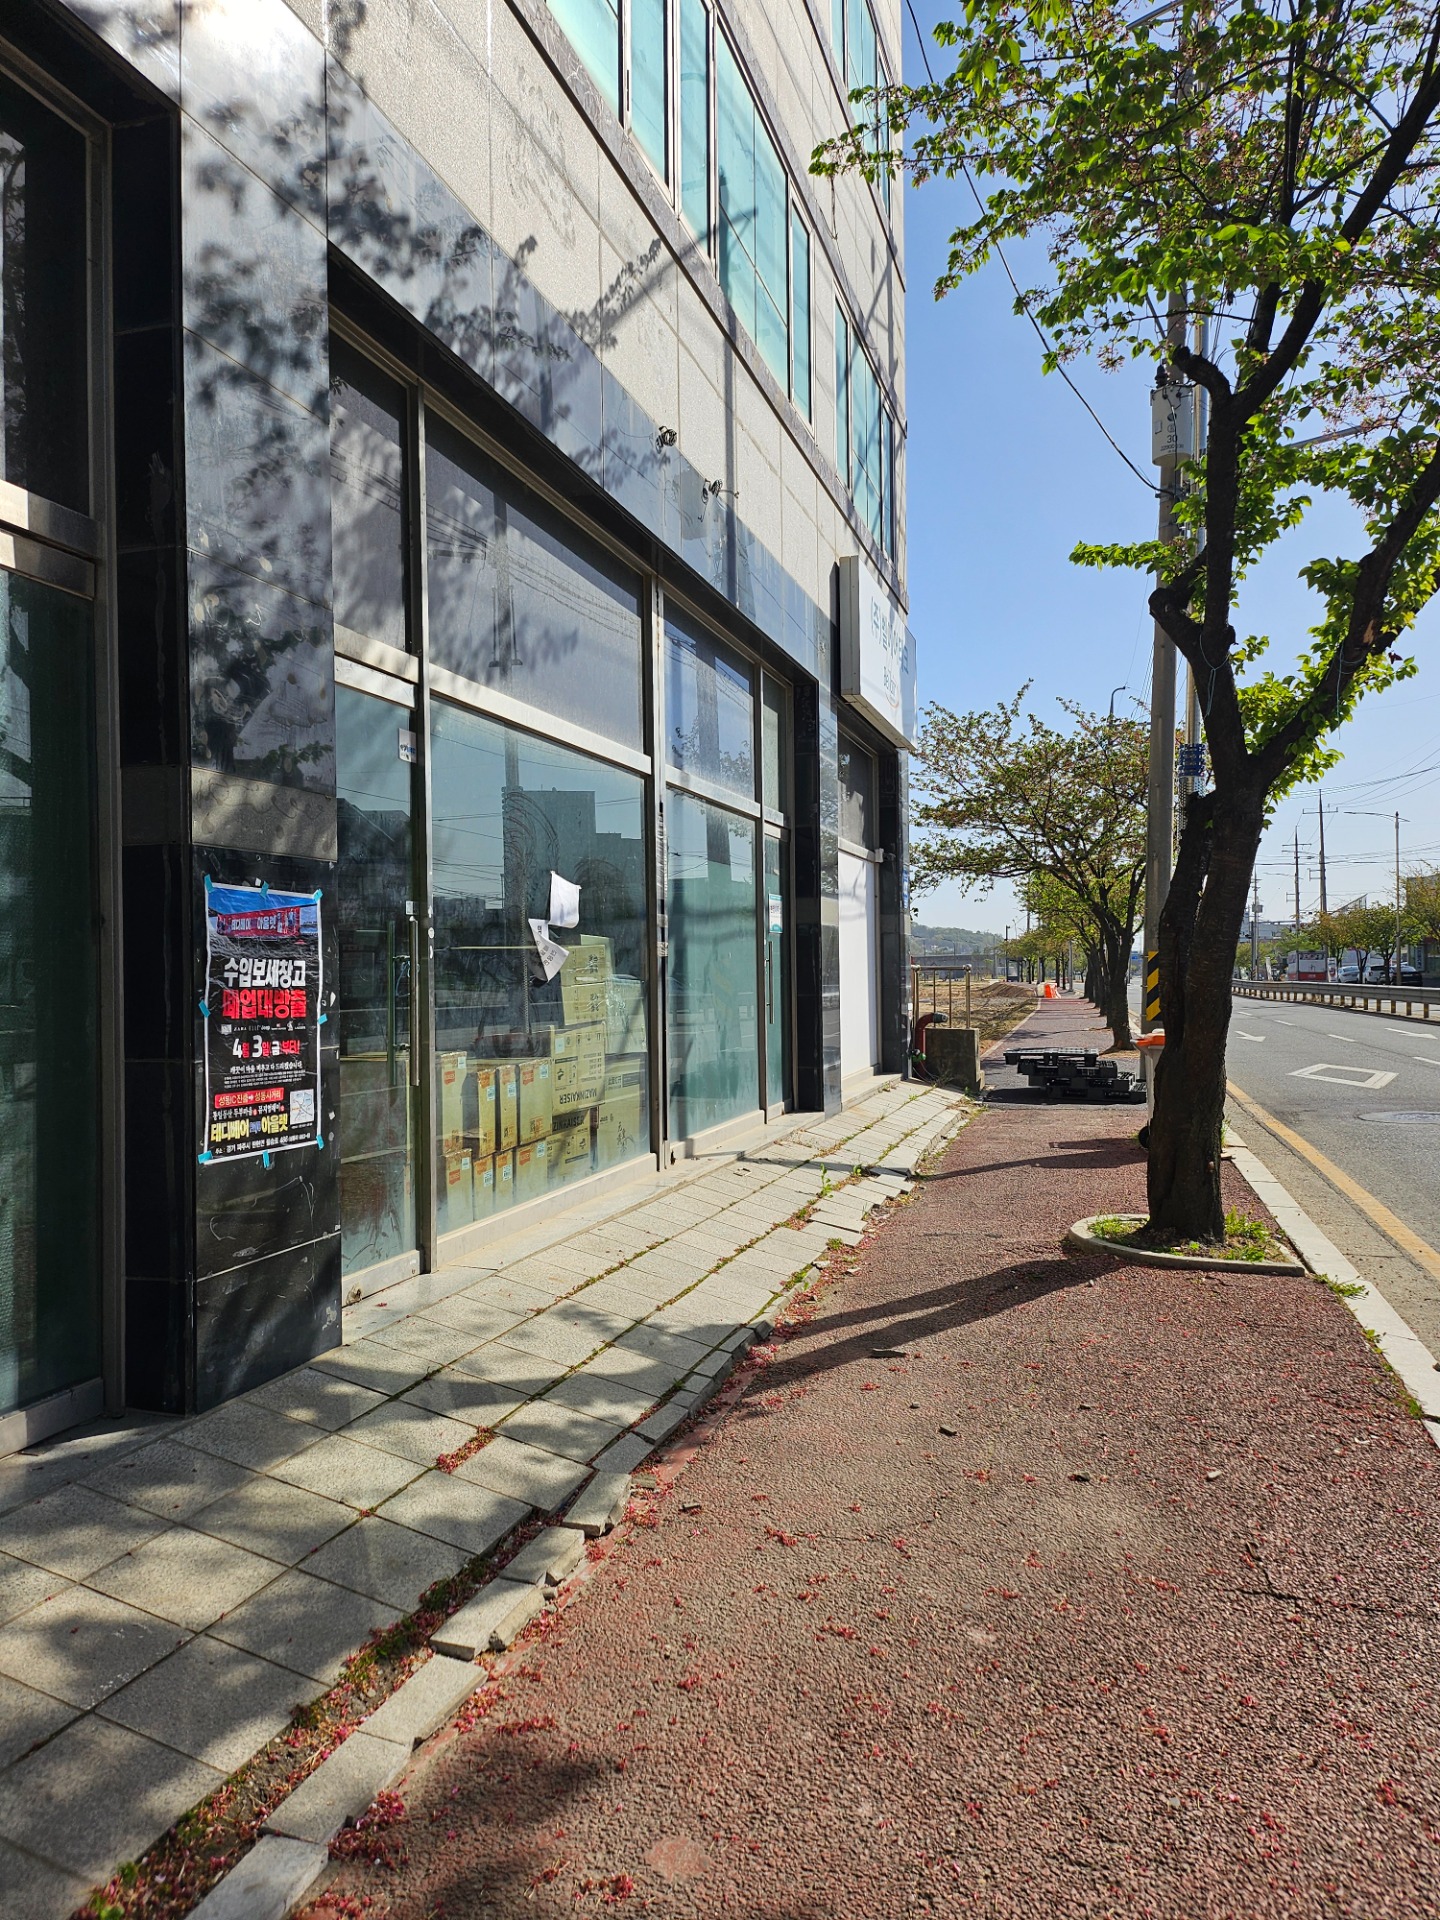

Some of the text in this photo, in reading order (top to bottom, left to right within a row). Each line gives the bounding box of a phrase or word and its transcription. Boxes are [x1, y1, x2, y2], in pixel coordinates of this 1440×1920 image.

[223, 957, 306, 988] 수입보세창고
[222, 989, 307, 1019] 폐업대방출
[559, 1087, 598, 1104] MAZINKAISER
[211, 1119, 249, 1142] 테디베어
[261, 1113, 288, 1134] 아울렛
